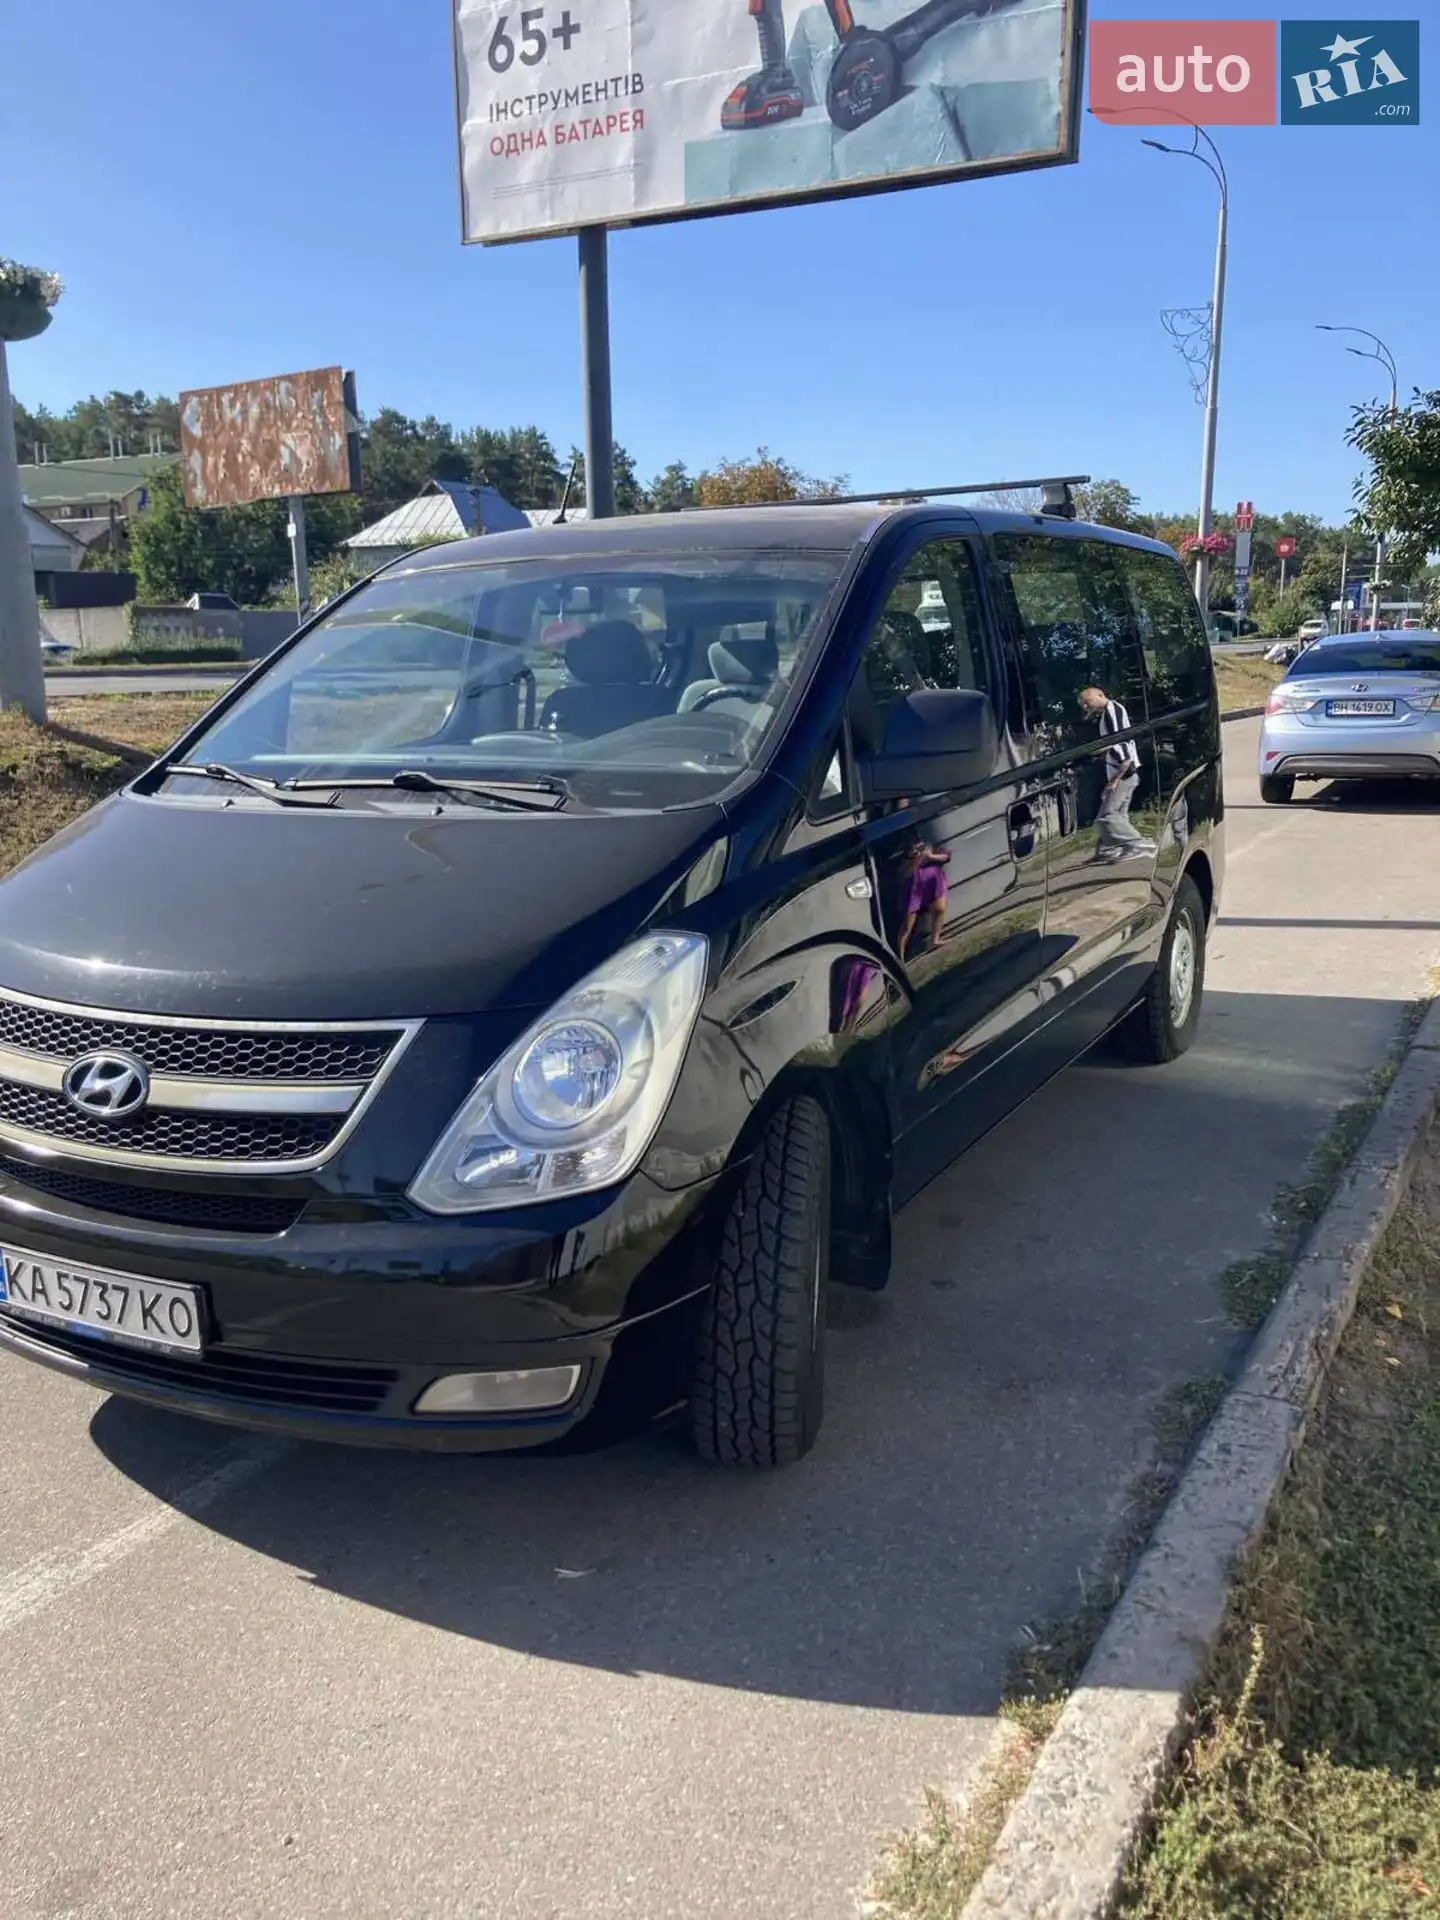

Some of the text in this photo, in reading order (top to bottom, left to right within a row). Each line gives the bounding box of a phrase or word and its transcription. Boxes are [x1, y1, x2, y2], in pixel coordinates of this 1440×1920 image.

[488, 7, 581, 74] 65+
[489, 73, 645, 123] ІНСТРУМЕНТІВ
[490, 108, 645, 159] ОДНА БАТАРЕЯ
[5, 1257, 52, 1307] KA
[56, 1270, 130, 1325] 5737
[139, 1288, 193, 1338] KO
